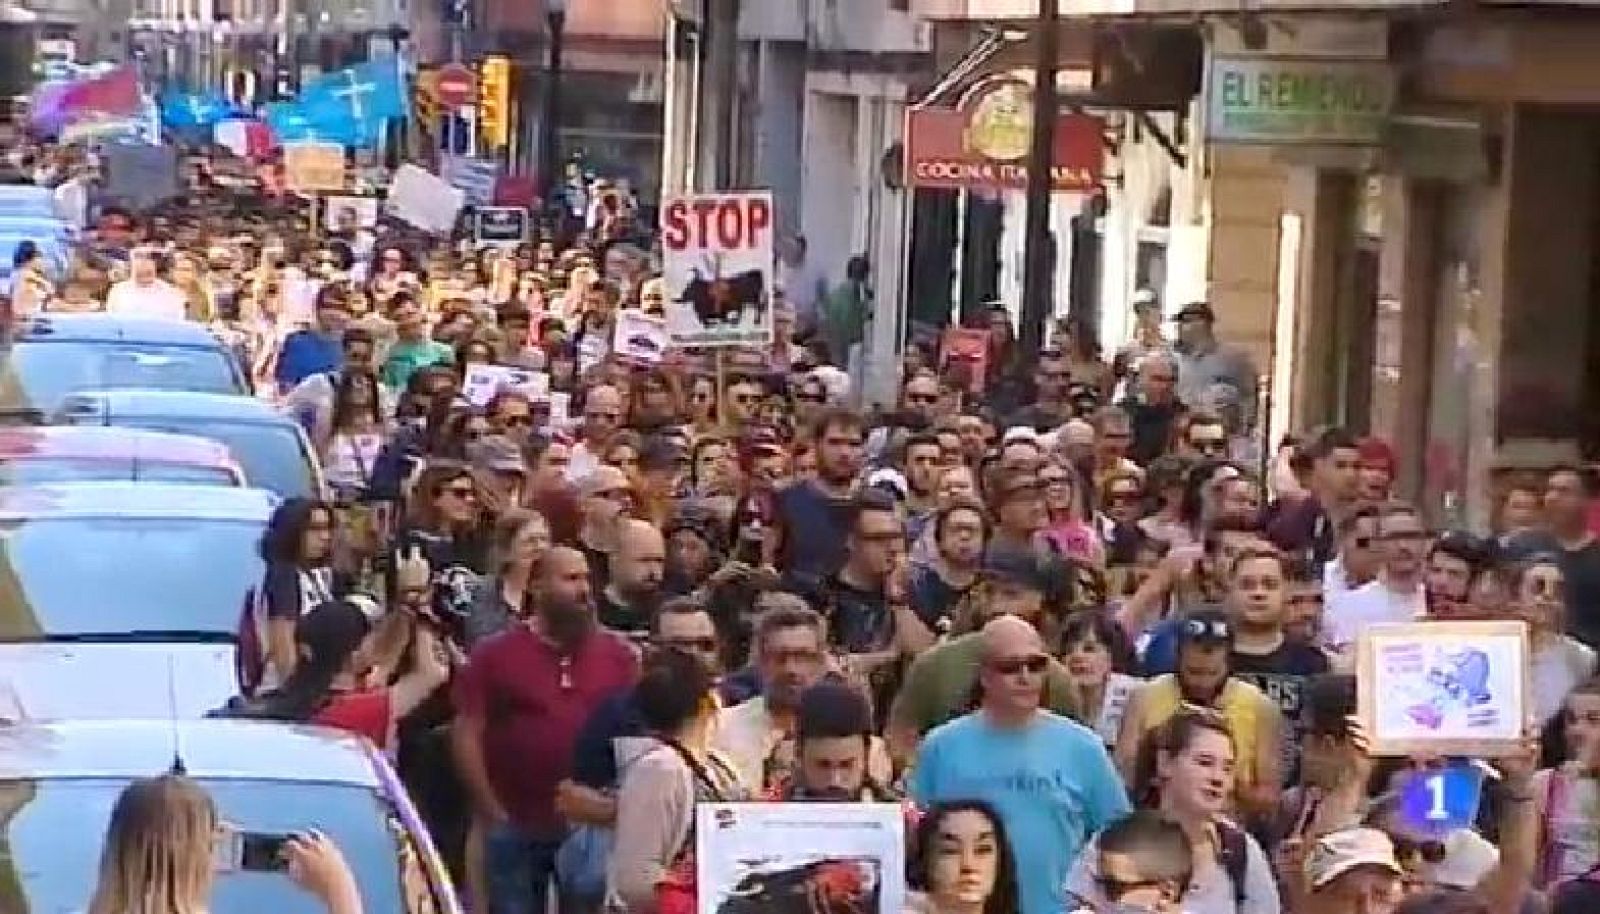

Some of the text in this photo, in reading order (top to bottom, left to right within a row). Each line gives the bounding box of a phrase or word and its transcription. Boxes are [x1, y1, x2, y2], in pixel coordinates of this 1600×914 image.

[1222, 69, 1250, 107] EL
[916, 161, 994, 181] COCINA
[665, 199, 769, 249] STOP
